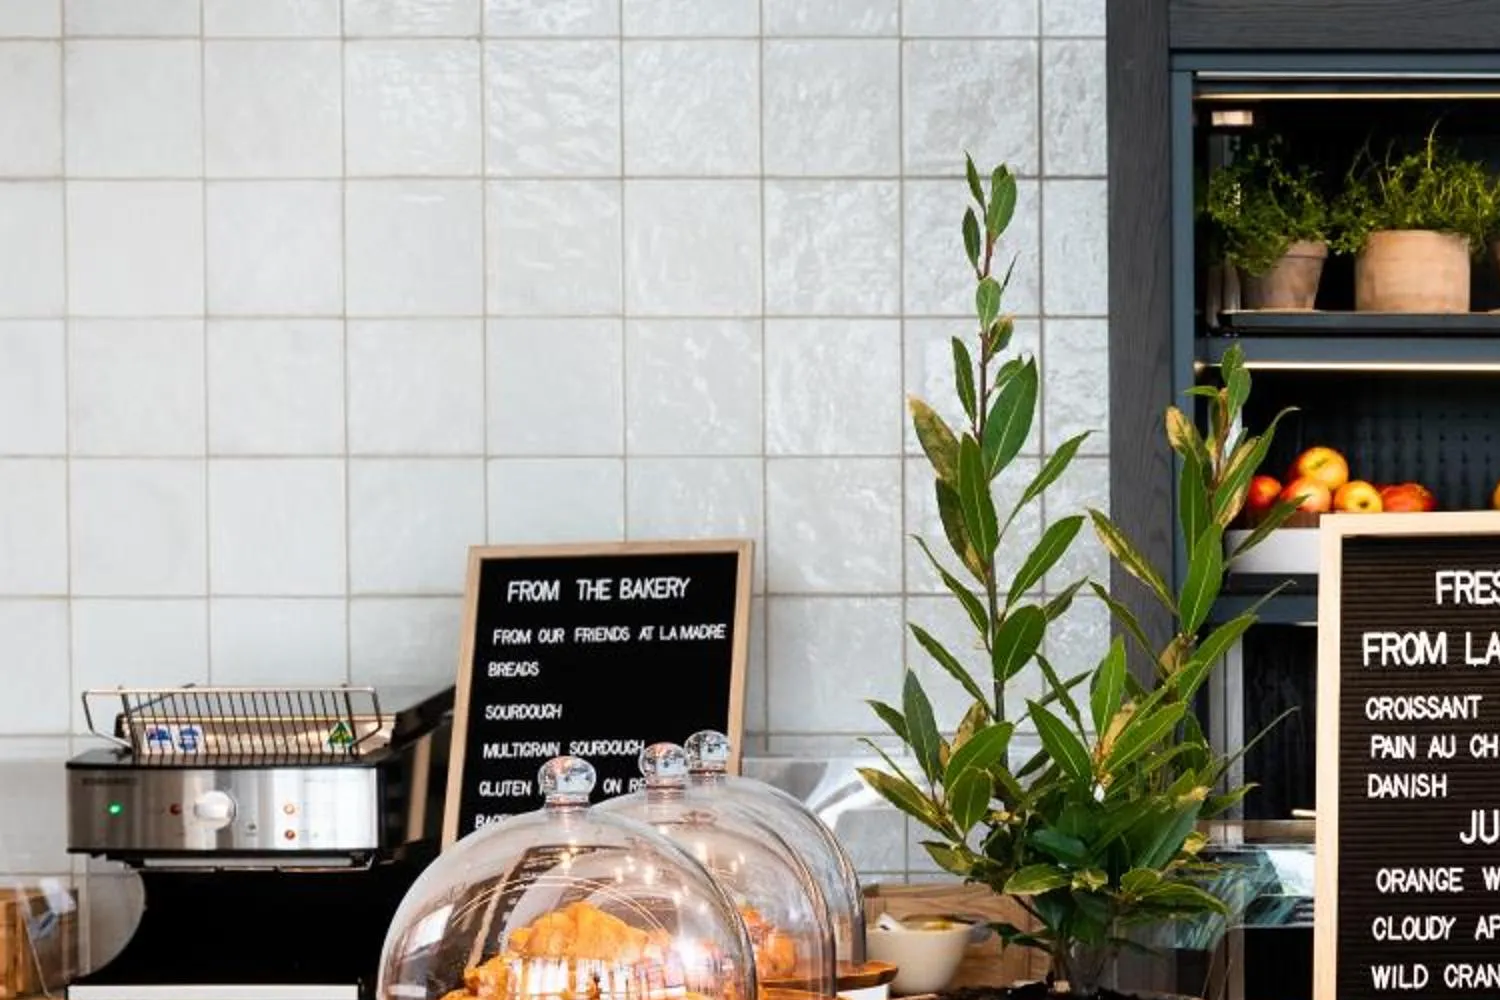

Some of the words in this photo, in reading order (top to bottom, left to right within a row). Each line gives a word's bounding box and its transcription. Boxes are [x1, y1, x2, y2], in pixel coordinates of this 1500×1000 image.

[507, 579, 561, 603] FROM
[575, 578, 613, 601] THE
[619, 576, 691, 600] BAKERY
[492, 628, 532, 645] FROM
[537, 627, 565, 644] OUR
[574, 625, 631, 643] FRIENDS
[638, 625, 655, 641] AT
[1361, 630, 1448, 667] FROM
[487, 661, 540, 678] BREADS
[484, 703, 563, 721] SOURDOUGH
[1365, 694, 1483, 721] CROISSANT
[569, 740, 645, 756] SOURDOUGH
[1370, 733, 1417, 760] PAIN
[1427, 734, 1457, 759] AU
[478, 779, 533, 797] GLUTEN
[603, 778, 623, 795] ON
[1367, 772, 1448, 799] DANISH
[1375, 866, 1465, 894] ORANGE
[1371, 915, 1457, 942] CLOUDY
[1370, 963, 1429, 990] WILD
